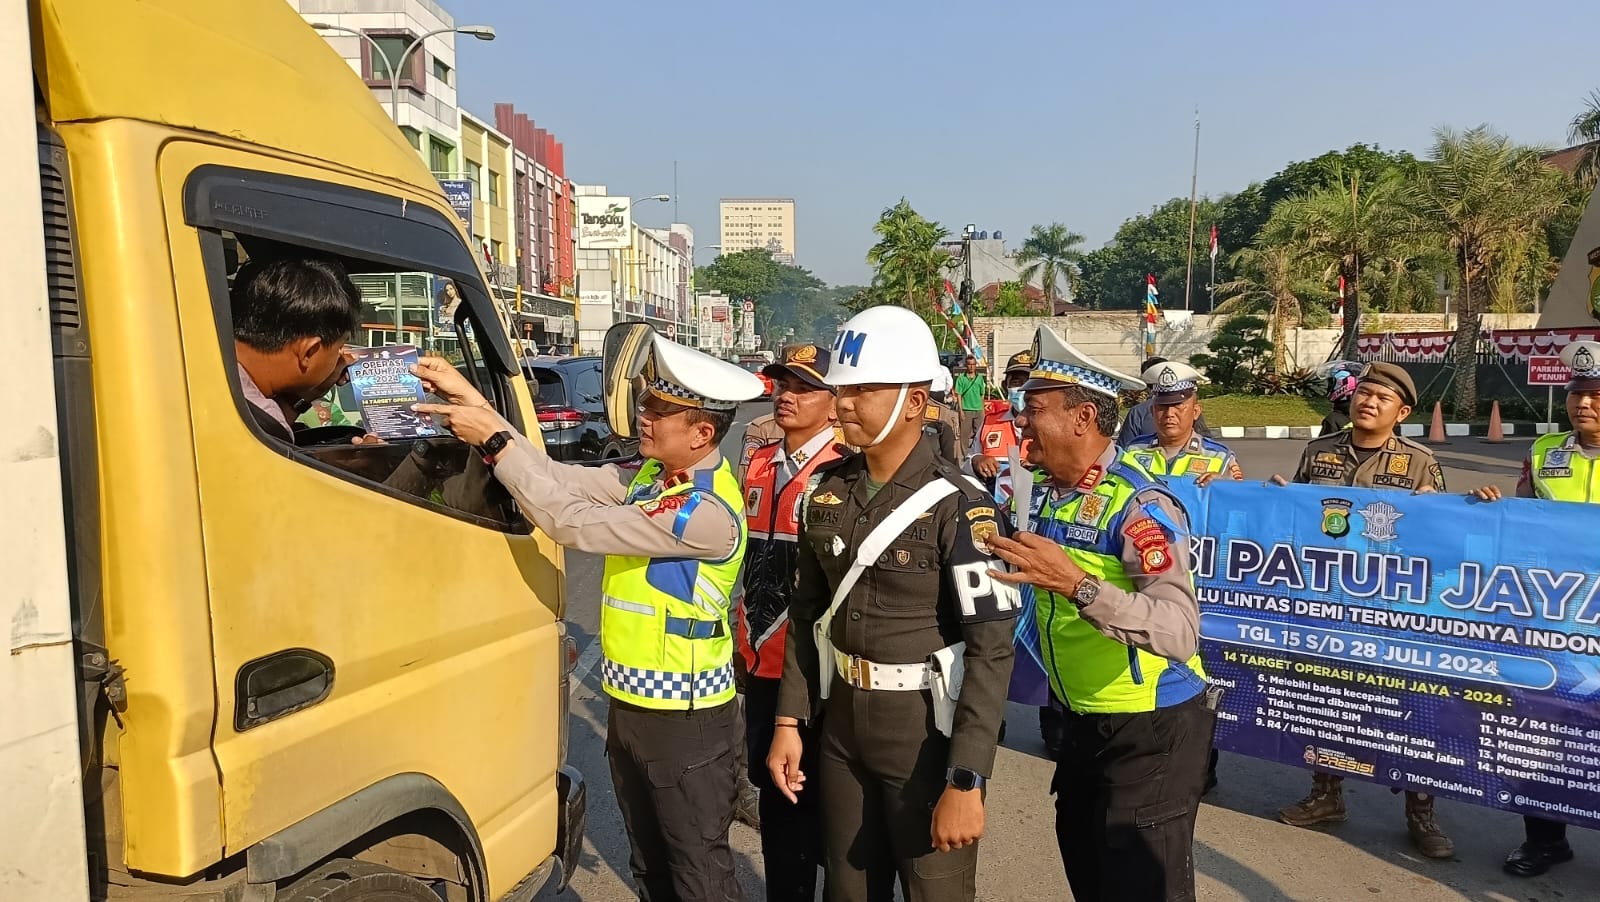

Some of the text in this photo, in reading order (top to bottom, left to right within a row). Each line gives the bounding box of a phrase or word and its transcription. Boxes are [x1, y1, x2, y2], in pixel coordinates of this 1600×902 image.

[355, 366, 407, 377] PATUH JAY
[362, 358, 404, 369] OPERASI
[376, 374, 400, 383] 2024
[1531, 365, 1571, 373] PARKIRAN
[1227, 538, 1427, 604] PATUH
[952, 560, 1022, 616] PM
[1198, 588, 1600, 654] LU LINTAS DEMI TERWUJUDNYA INDON
[1237, 623, 1499, 677] TGL 15 S/D 28 JULI 2024
[1206, 676, 1235, 688] lkohol
[1223, 651, 1238, 663] 14
[1239, 653, 1293, 671] TARGET
[1294, 662, 1354, 682] OPERASI
[1356, 672, 1406, 690] PATUH
[1408, 681, 1450, 697] JAYA
[1463, 689, 1503, 706] 2024
[1258, 673, 1399, 705] 6. Melebihi batas kecepatan
[1257, 685, 1412, 720] 7. Berkendara dibawah umur /
[1267, 697, 1361, 722] Tidak memiliki SIM
[1256, 707, 1436, 748] 8. R2 berboncengan lebih dari satu
[1480, 711, 1498, 723] 10.
[1501, 714, 1518, 726] R2
[1519, 717, 1528, 729] /
[1530, 719, 1547, 731] R4
[1550, 723, 1583, 737] tidak
[1480, 724, 1494, 735] 11.
[1496, 726, 1562, 746] Melanggar
[1255, 718, 1265, 727] 9.
[1267, 719, 1281, 729] R4
[1282, 722, 1290, 732] /
[1290, 724, 1316, 736] lebih
[1317, 730, 1344, 743] tidak
[1345, 736, 1402, 754] memenuhi
[1403, 746, 1435, 761] layak
[1435, 752, 1465, 767] jalan
[1479, 736, 1600, 767] 12. Memasang rotat
[1318, 754, 1375, 774] PRESISI
[1477, 761, 1600, 793] 14. Penertiban parki
[1478, 748, 1600, 780] 13. Menggunakan pl
[1405, 772, 1484, 797] TMCPoldaMetro
[1514, 794, 1600, 820] @tmcpoldametr
